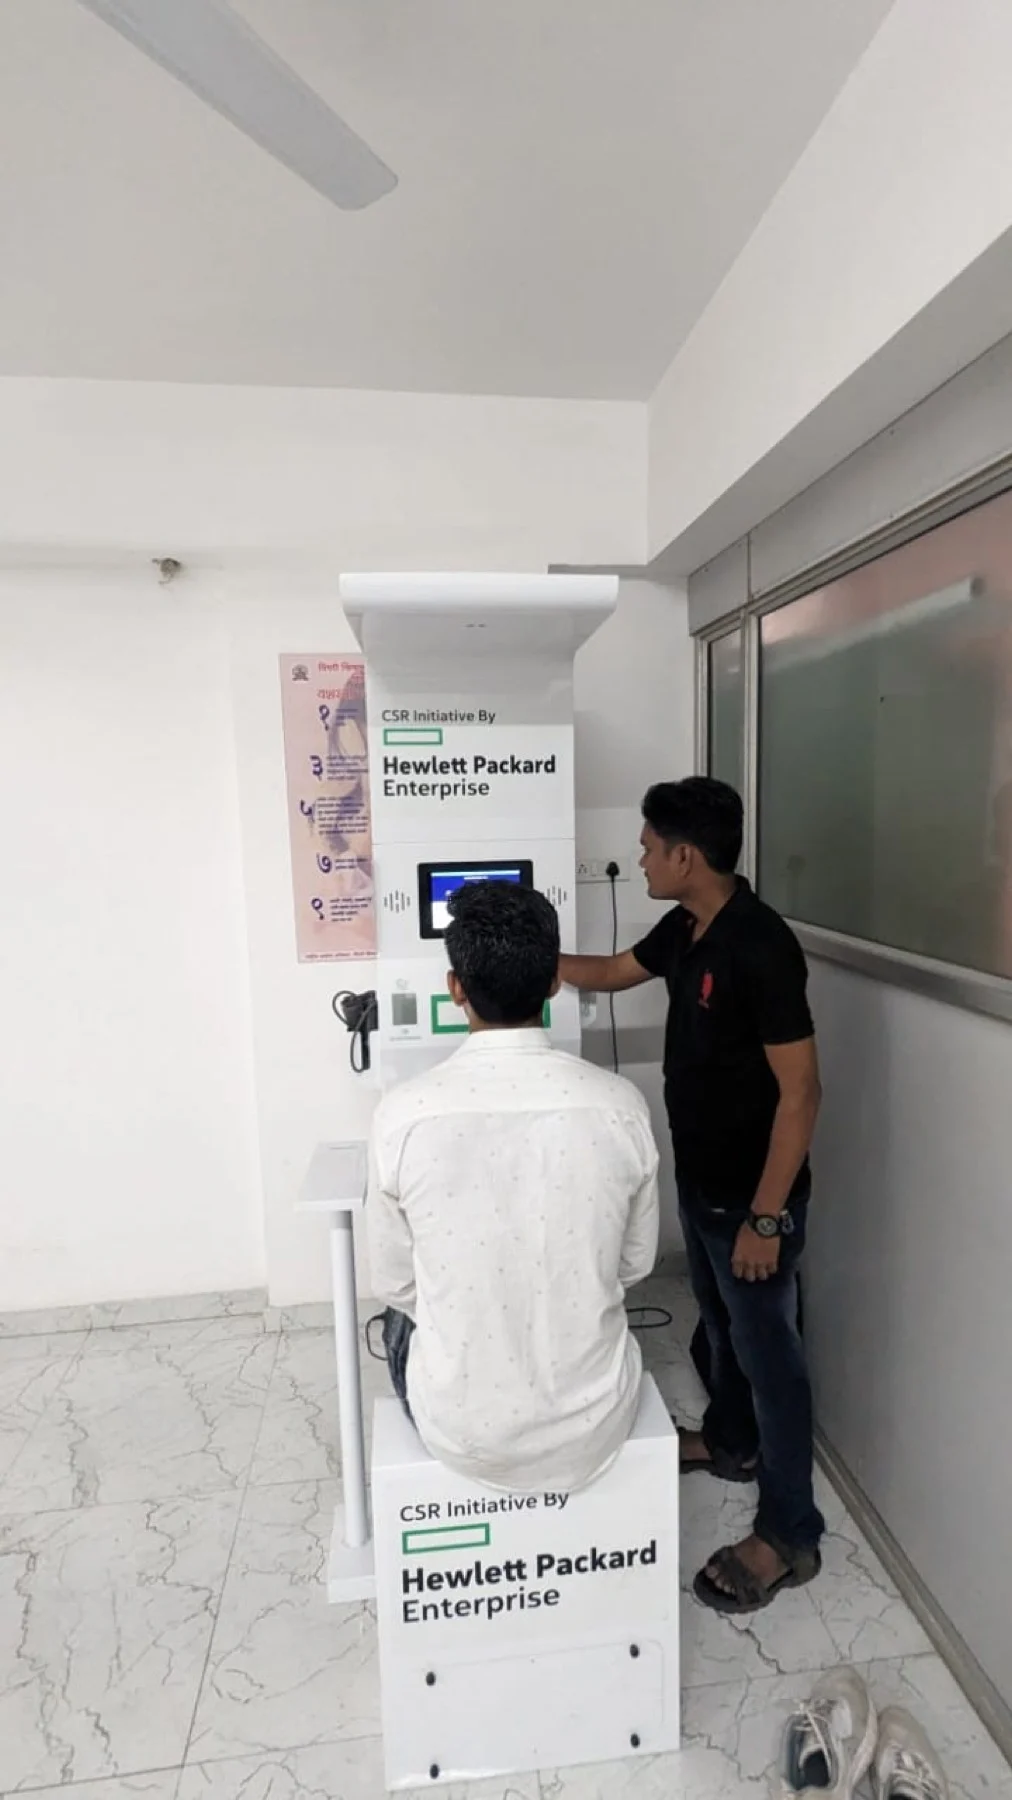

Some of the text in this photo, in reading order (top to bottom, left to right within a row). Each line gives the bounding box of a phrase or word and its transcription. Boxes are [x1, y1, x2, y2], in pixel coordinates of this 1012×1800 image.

[381, 708, 496, 725] CSR Initiative By
[383, 754, 468, 775] Hewlett
[473, 754, 557, 774] Packard
[383, 778, 490, 800] Enterprise
[399, 1502, 441, 1522] CSR
[447, 1493, 538, 1518] Initiative
[402, 1539, 658, 1594] Hewlett Packard
[402, 1586, 561, 1624] Enterprise
